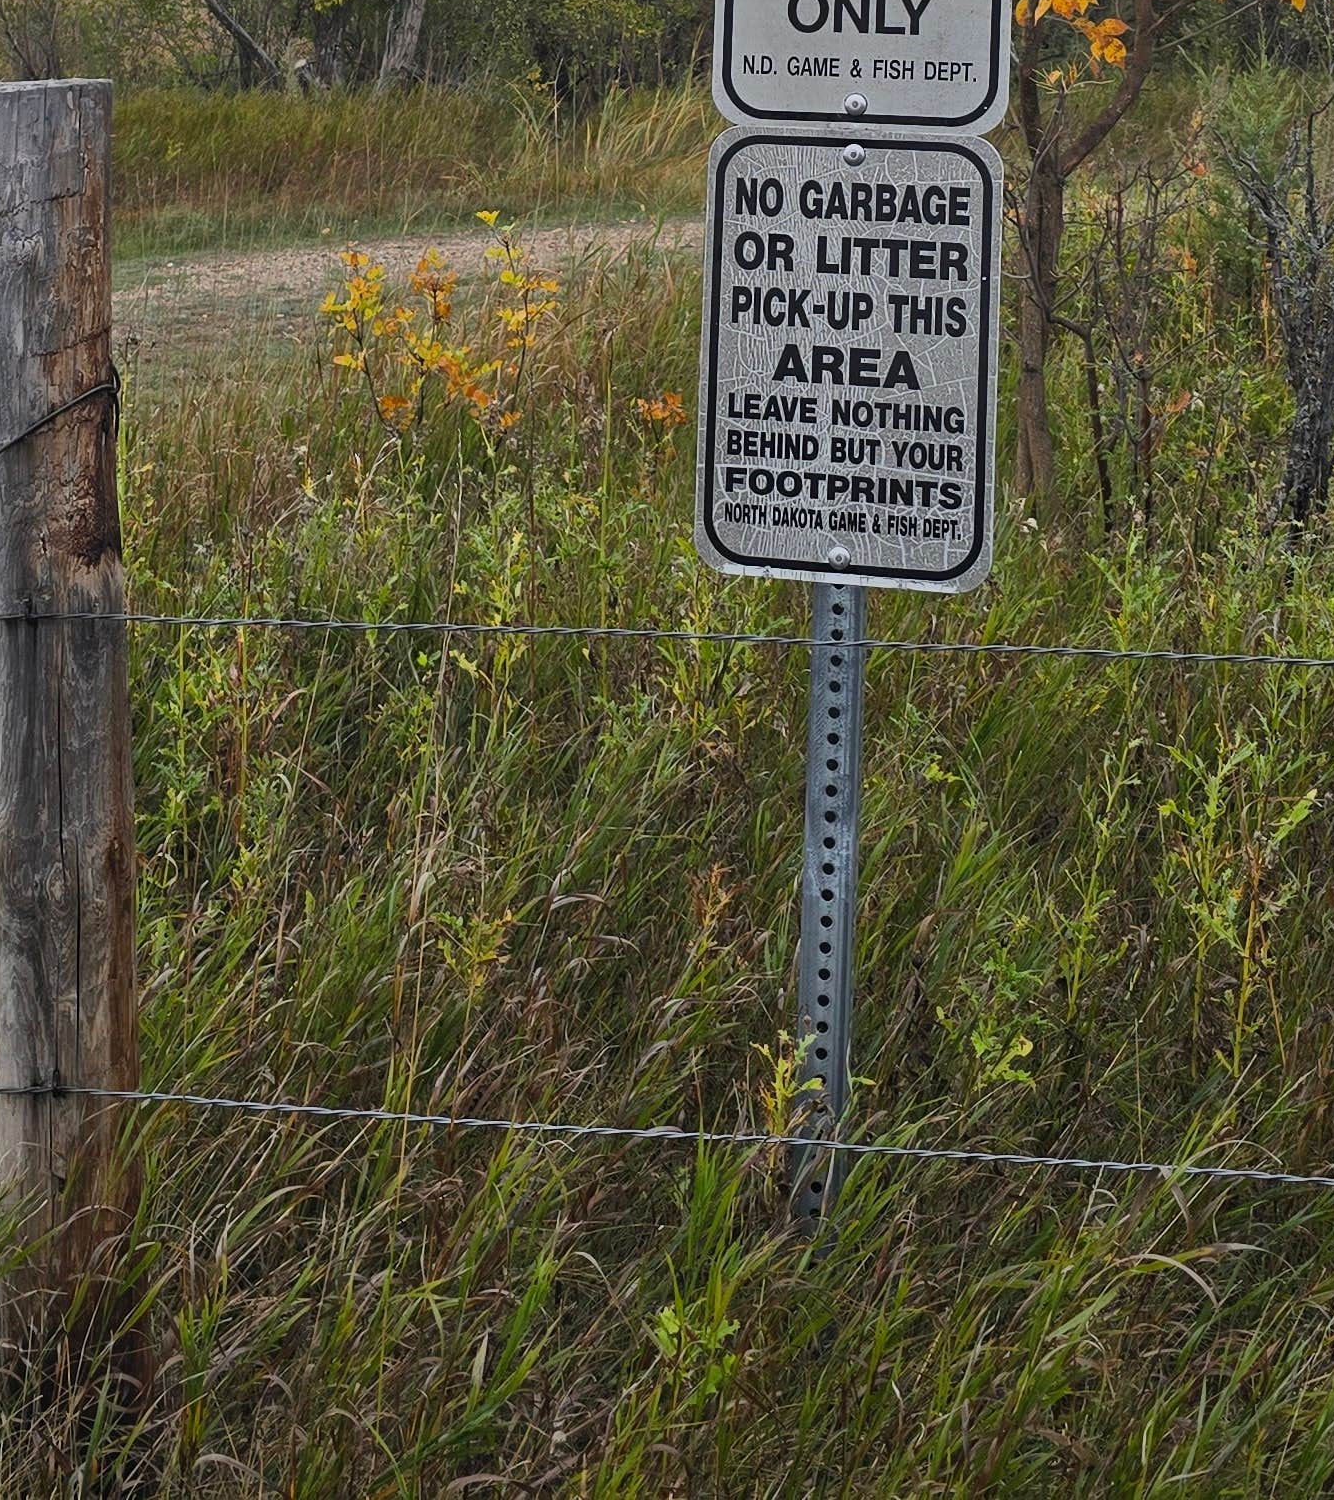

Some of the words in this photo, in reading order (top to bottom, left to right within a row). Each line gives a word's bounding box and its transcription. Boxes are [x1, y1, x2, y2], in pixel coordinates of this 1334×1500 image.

[743, 54, 776, 76] N.D.
[787, 56, 840, 78] GAME
[850, 59, 862, 78] &
[873, 59, 914, 80] FISH
[924, 61, 977, 82] DEPT.
[735, 177, 784, 216] NO
[800, 181, 969, 226] GARBAGE
[734, 231, 794, 272] OR
[816, 236, 968, 281] LITTER
[732, 286, 873, 331] PICK-UP
[888, 295, 966, 337] THIS
[771, 344, 921, 390] AREA
[728, 393, 818, 424] LEAVE
[832, 400, 964, 434] NOTHING
[727, 430, 819, 461] BEHIND
[831, 438, 881, 465] BUT
[893, 441, 963, 472] YOUR
[725, 467, 962, 510] FOOTPRINTS
[724, 506, 767, 526] NORTH
[772, 507, 823, 529] DAKOTA
[828, 510, 866, 533] GAME
[872, 514, 881, 534] &
[887, 514, 918, 536] FISH
[923, 517, 961, 540] DEPT.
